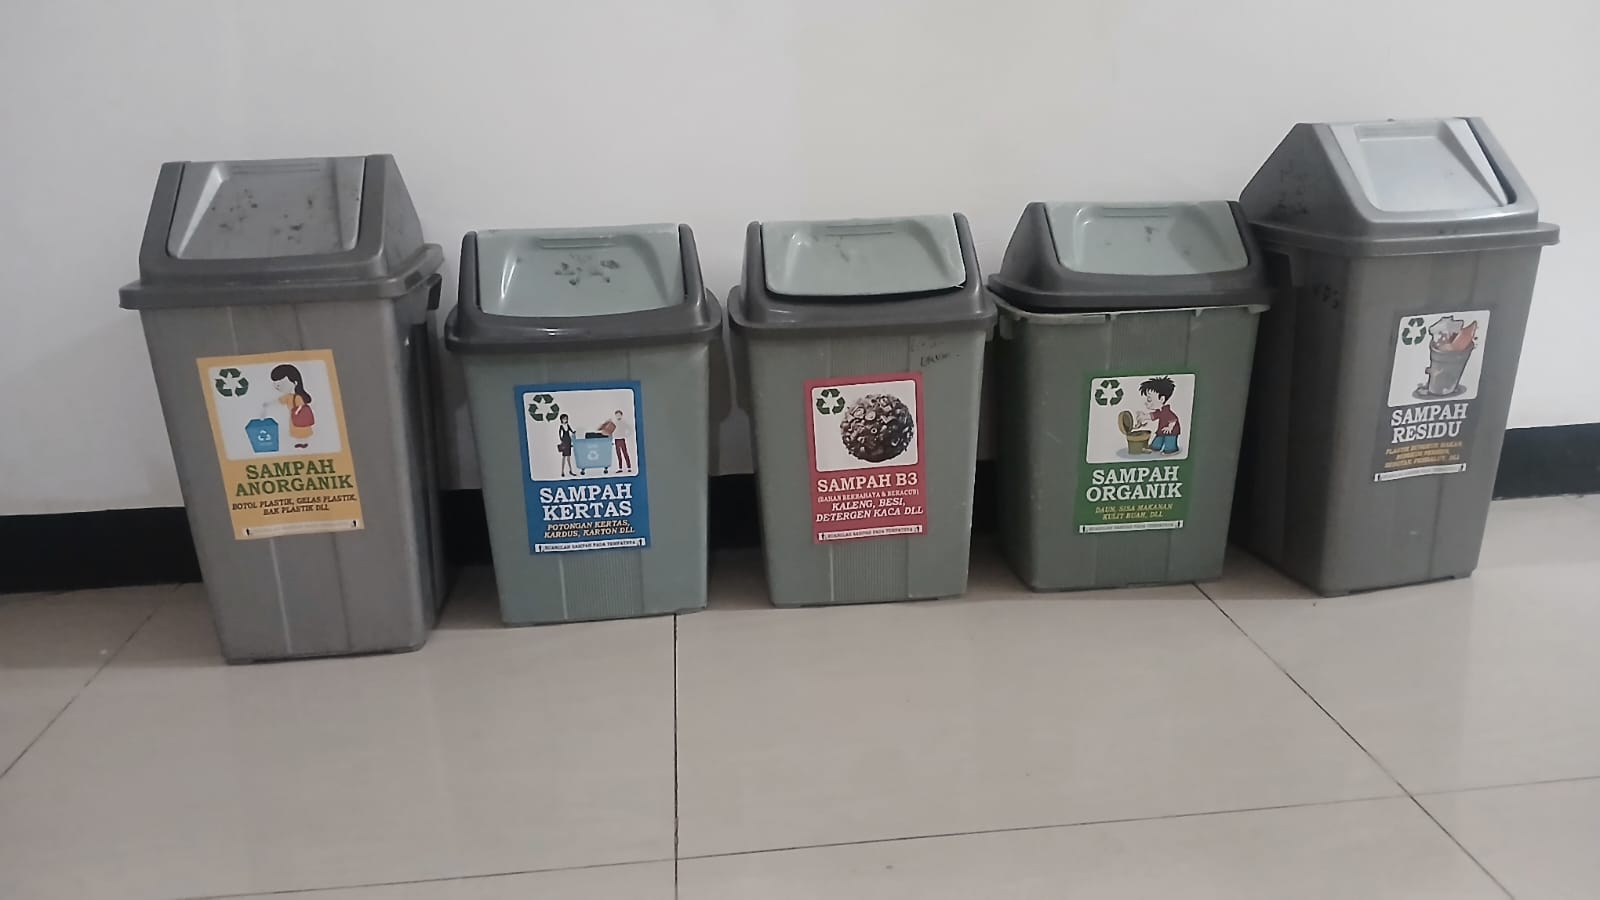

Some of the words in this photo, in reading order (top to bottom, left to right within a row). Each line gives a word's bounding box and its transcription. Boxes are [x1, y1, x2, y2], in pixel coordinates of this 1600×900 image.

[1391, 403, 1469, 426] SAMPAH
[1391, 421, 1462, 444] RESIDU
[246, 459, 336, 480] SAMPAH
[1092, 465, 1180, 485] SAMPAH
[236, 475, 354, 497] ANORGANIK
[817, 473, 892, 493] SAMPAH
[895, 472, 918, 486] B3
[539, 483, 633, 503] SAMPAH
[1086, 483, 1183, 502] ORGANIK
[232, 502, 258, 511] BOTOL
[296, 496, 321, 504] GELAS
[281, 505, 314, 514] PLASTIK
[315, 503, 330, 511] DLL
[542, 500, 632, 521] KERTAS
[831, 500, 876, 512] KALENG,
[878, 497, 907, 508] BESI,
[1119, 504, 1135, 513] SISA
[1137, 503, 1174, 511] MAKANAN
[815, 511, 871, 522] DETERGEN
[873, 508, 901, 517] KACA
[903, 506, 924, 515] DLL
[547, 521, 593, 531] POTONGAN
[583, 527, 618, 536] KARTON
[619, 526, 635, 534] DLL
